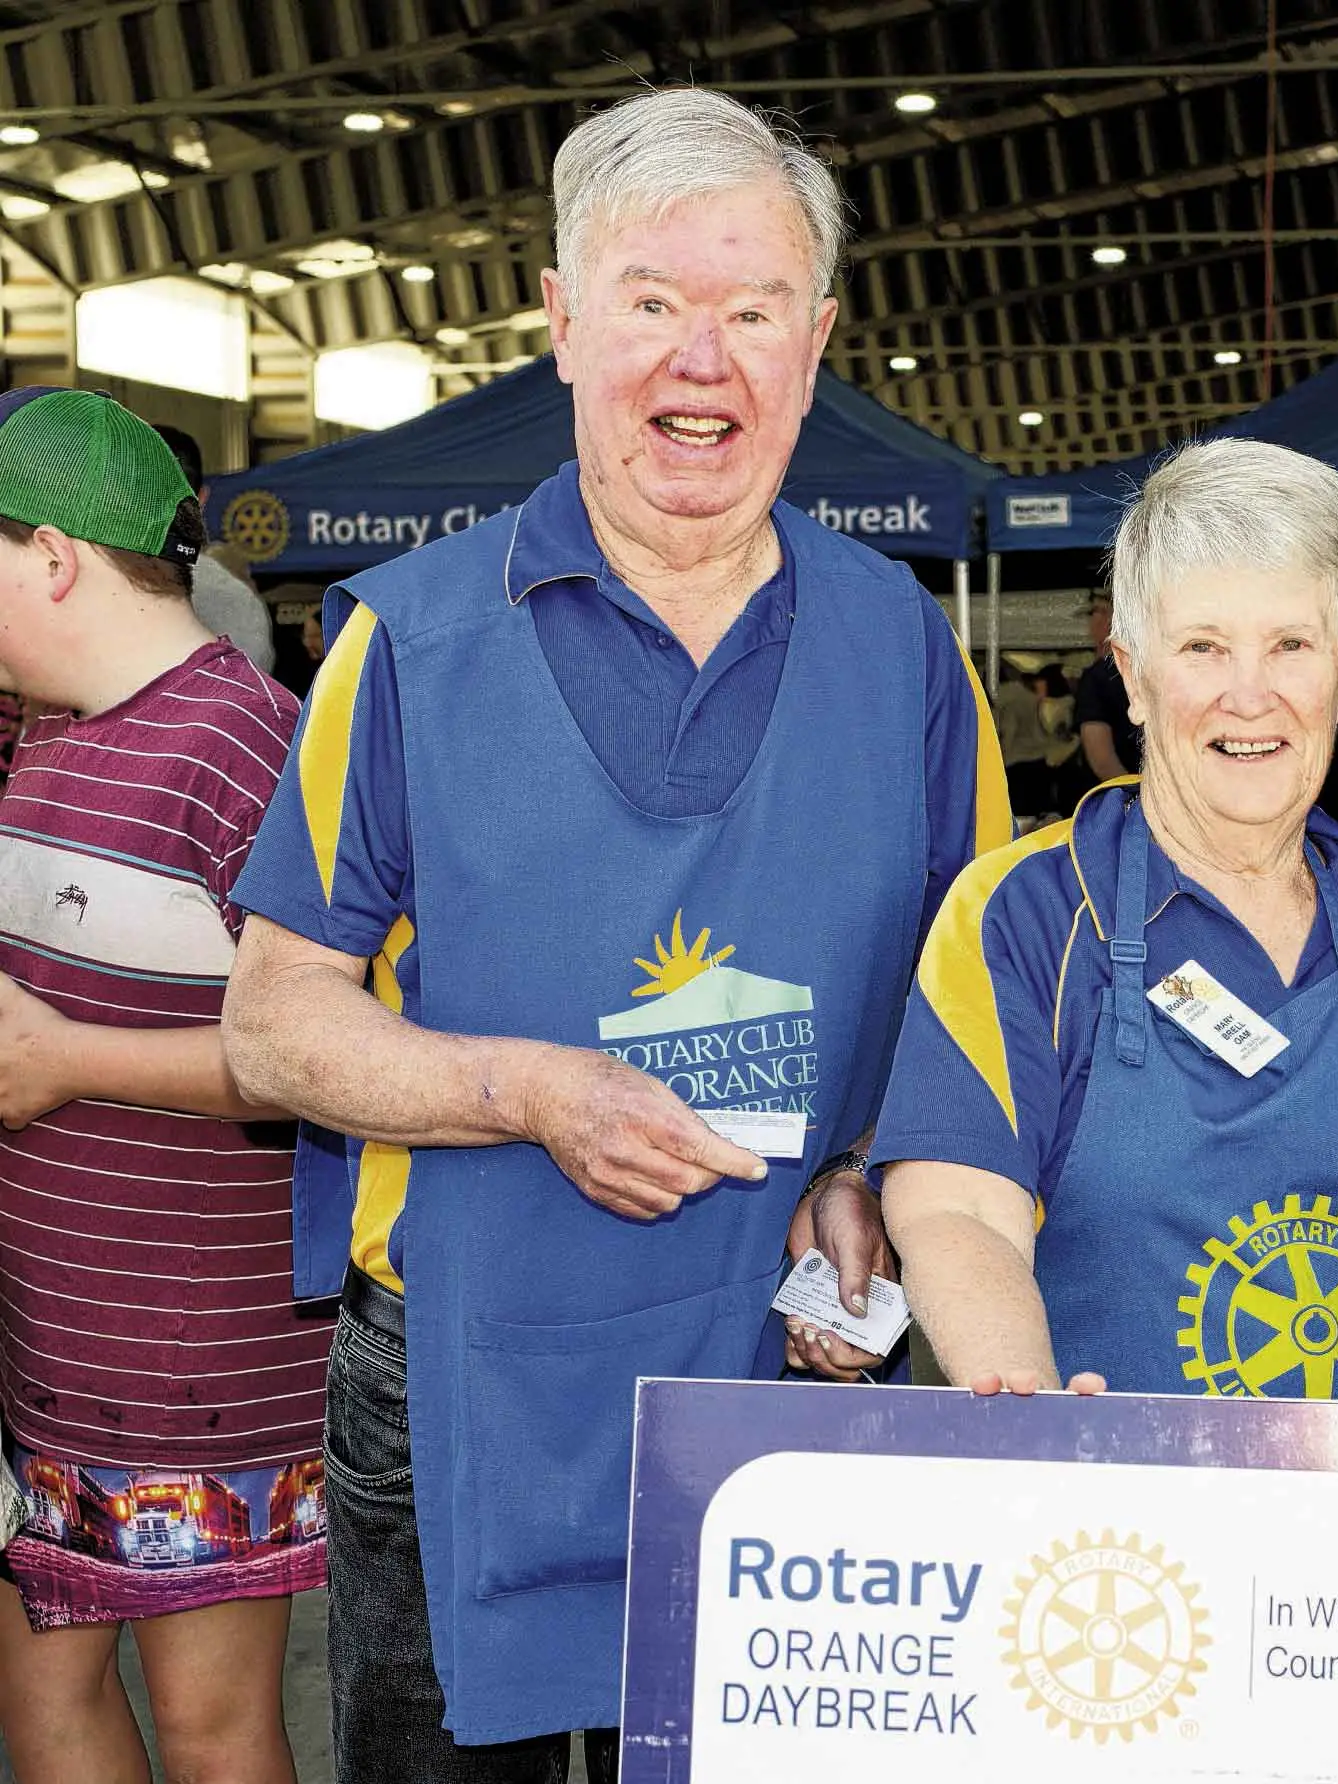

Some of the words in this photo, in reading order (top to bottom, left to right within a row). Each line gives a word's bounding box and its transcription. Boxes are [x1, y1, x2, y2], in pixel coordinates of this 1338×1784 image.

[308, 508, 431, 548] Rotary
[808, 495, 931, 533] break
[737, 1017, 815, 1055] CLUB
[1213, 1013, 1235, 1033] MARY
[1221, 1022, 1247, 1041] BRELL
[1233, 1030, 1252, 1045] OAM
[666, 1052, 819, 1105] ORANGE
[1249, 1221, 1338, 1257] ROTARY
[728, 1537, 983, 1623] Rotary
[1064, 1551, 1150, 1575] ROTARY
[1267, 1595, 1293, 1626] In
[748, 1628, 955, 1678] ORANGE
[722, 1683, 978, 1735] DAYBREAK
[1034, 1668, 1178, 1722] INTERNATIONAL
